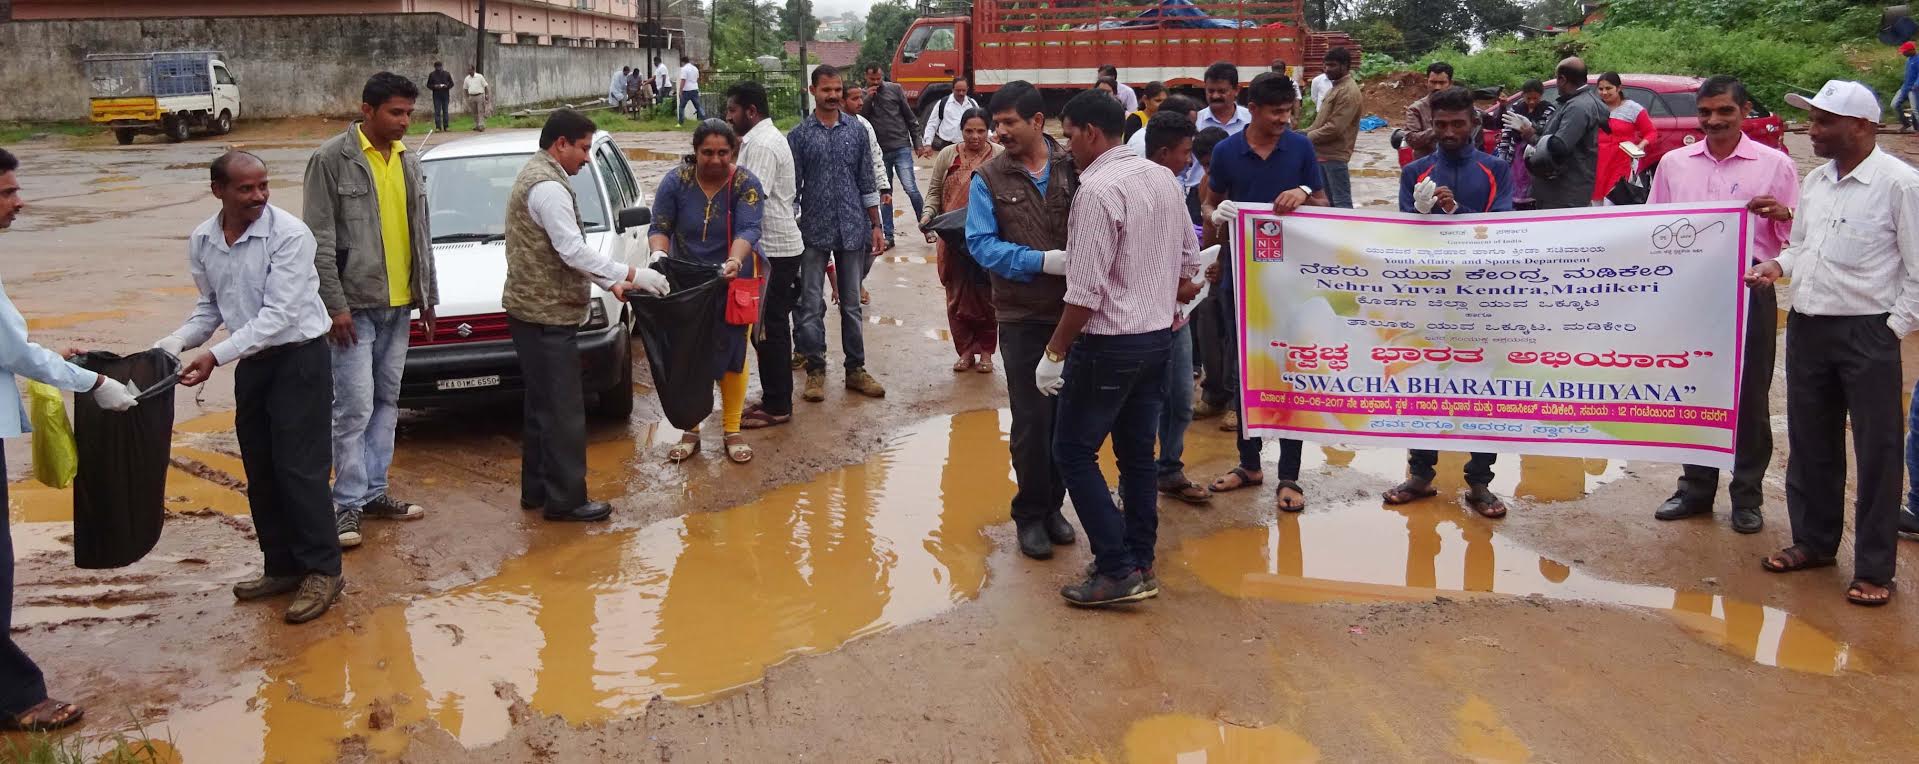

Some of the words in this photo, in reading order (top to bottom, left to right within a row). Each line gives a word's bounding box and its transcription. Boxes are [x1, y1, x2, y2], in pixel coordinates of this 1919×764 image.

[1485, 258, 1521, 266] Sports
[1524, 257, 1591, 265] Department
[1300, 262, 1369, 277] ನೆಹರು
[1382, 268, 1451, 280] ಯುವ
[1563, 264, 1673, 279] ಮಡಿಕೇರಿ
[1317, 278, 1383, 293] Nehru
[1392, 283, 1446, 295] Yuva
[1357, 295, 1417, 307] ಕೊಡಗು
[1479, 299, 1528, 308] ಯುವ
[1539, 299, 1600, 311] ಒಕ್ಕೂಟ
[1426, 322, 1475, 331] ಯುವ
[1562, 321, 1637, 332] ಮಡಿಕೇರಿ
[1371, 345, 1484, 363] ಭಾರತ
[1407, 376, 1533, 398] BHARATH
[1293, 395, 1343, 408] 09-06-2017
[1580, 405, 1609, 416] ಸಮಯ
[1618, 406, 1627, 417] 12
[1462, 421, 1523, 433] ಆದರದ
[1532, 424, 1590, 438] ಸ್ವಾಗತ
